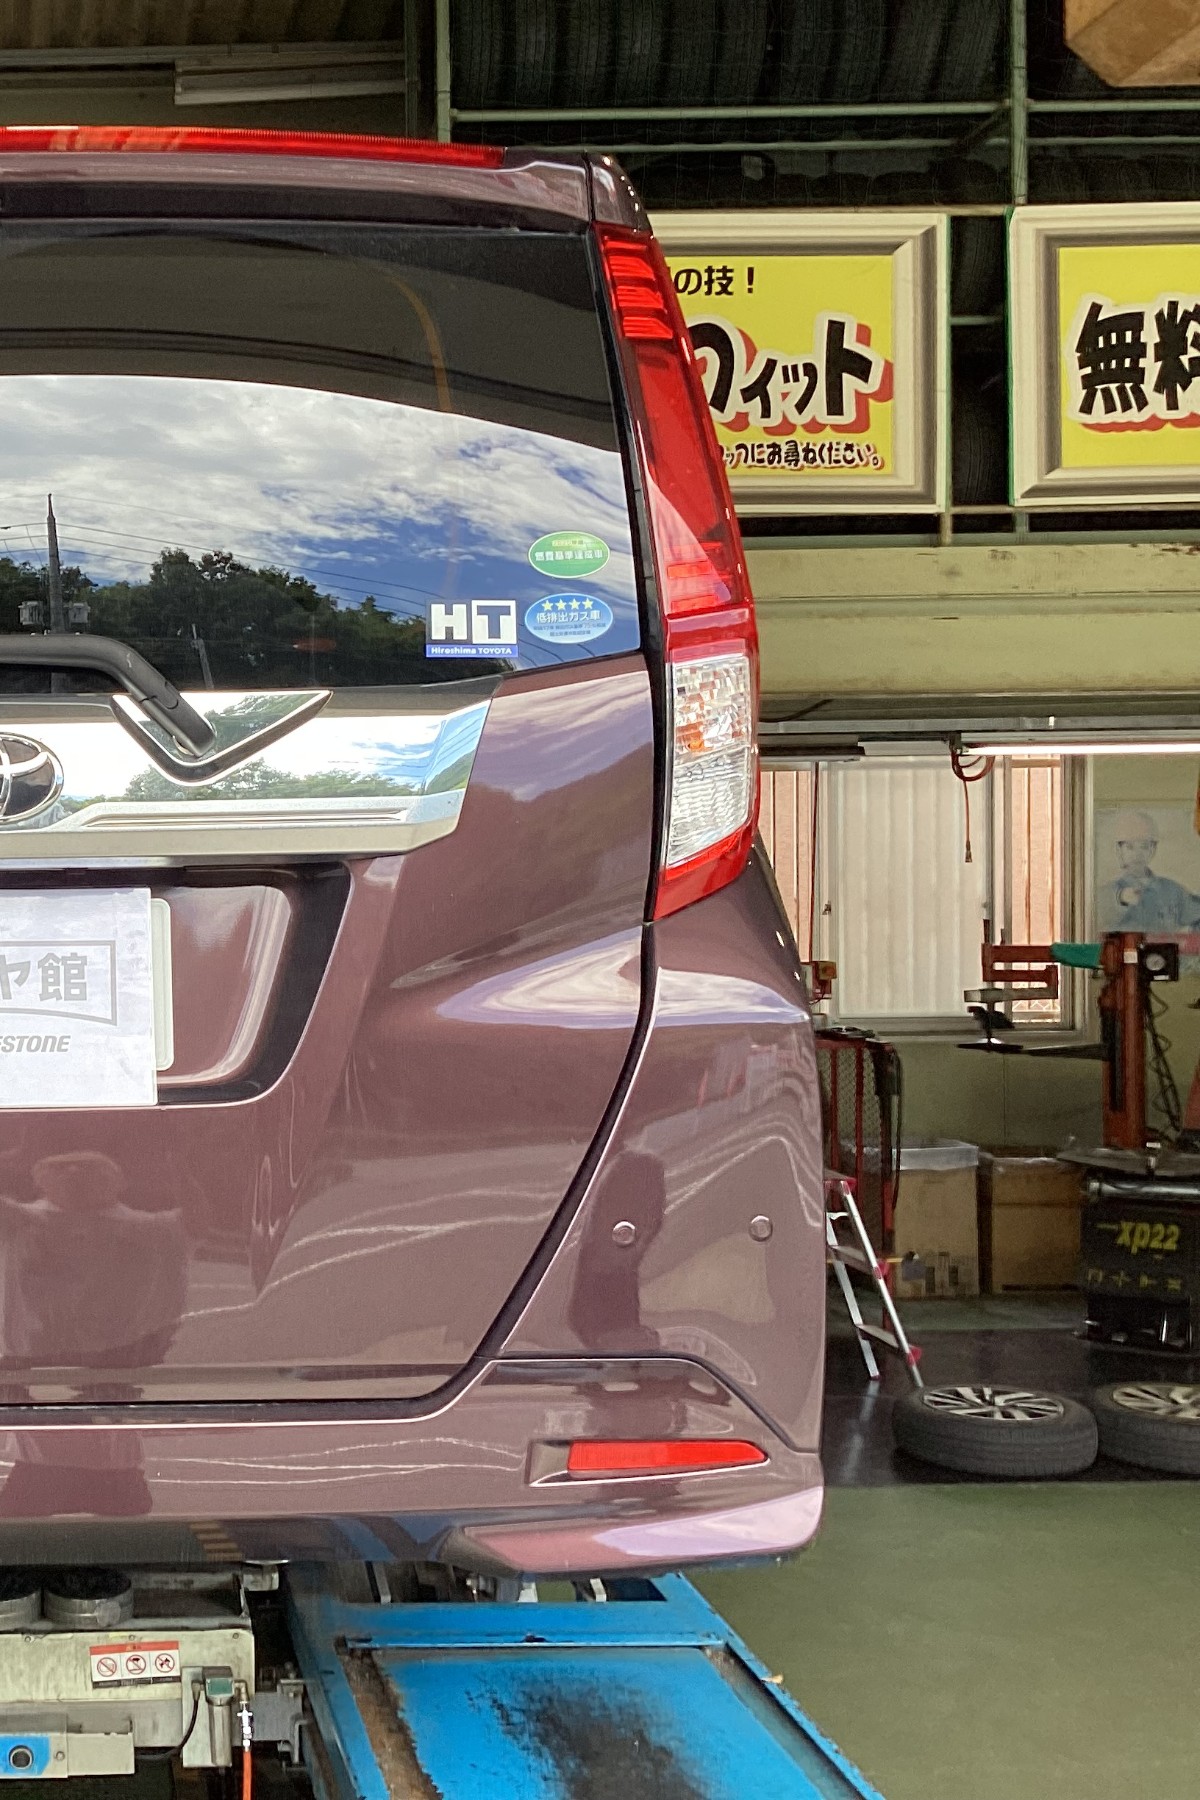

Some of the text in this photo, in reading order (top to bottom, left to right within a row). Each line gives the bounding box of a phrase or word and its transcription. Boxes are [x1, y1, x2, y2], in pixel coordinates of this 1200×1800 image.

[668, 266, 755, 296] の技！
[430, 600, 517, 644] HT
[536, 610, 601, 623] 低排出ガス車
[431, 647, 513, 655] Hiroshima TOYOTA
